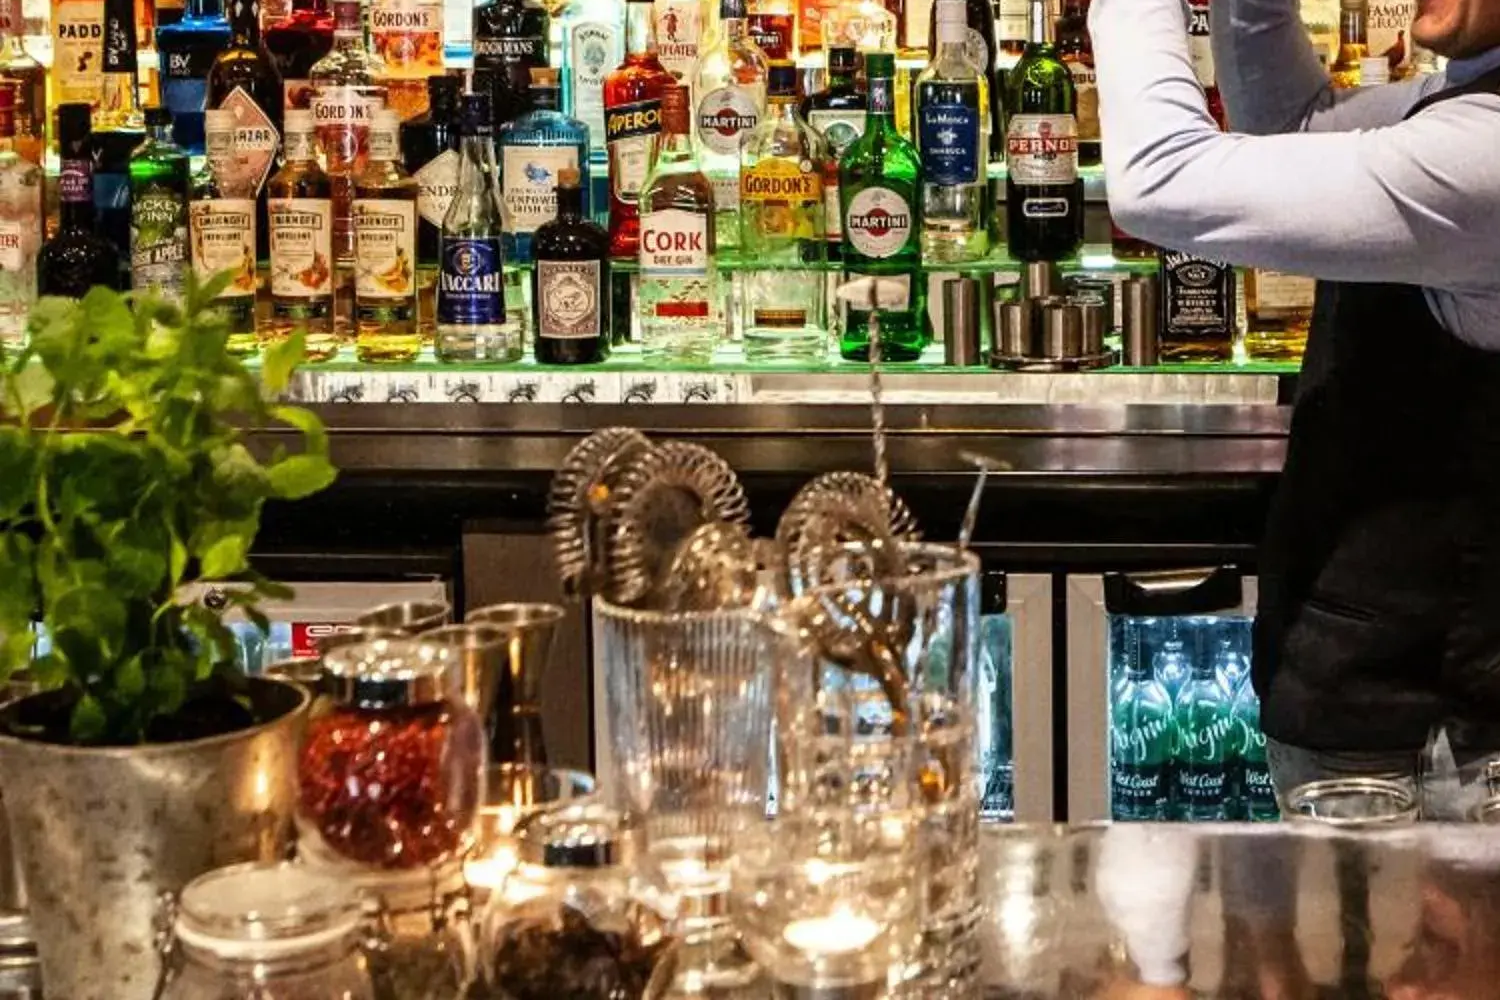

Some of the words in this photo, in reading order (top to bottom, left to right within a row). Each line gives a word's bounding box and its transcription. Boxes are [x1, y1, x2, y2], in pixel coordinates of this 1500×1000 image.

[1367, 3, 1412, 17] FAMOU
[1368, 16, 1409, 29] GROU
[59, 23, 102, 39] PADD
[169, 53, 191, 69] BV
[702, 115, 757, 130] MARTINI
[233, 127, 272, 142] AZAR
[744, 174, 813, 194] GORDON'S
[850, 214, 909, 229] MARTINI
[643, 229, 702, 254] CORK
[653, 255, 673, 265] DRY
[675, 255, 694, 265] GIN
